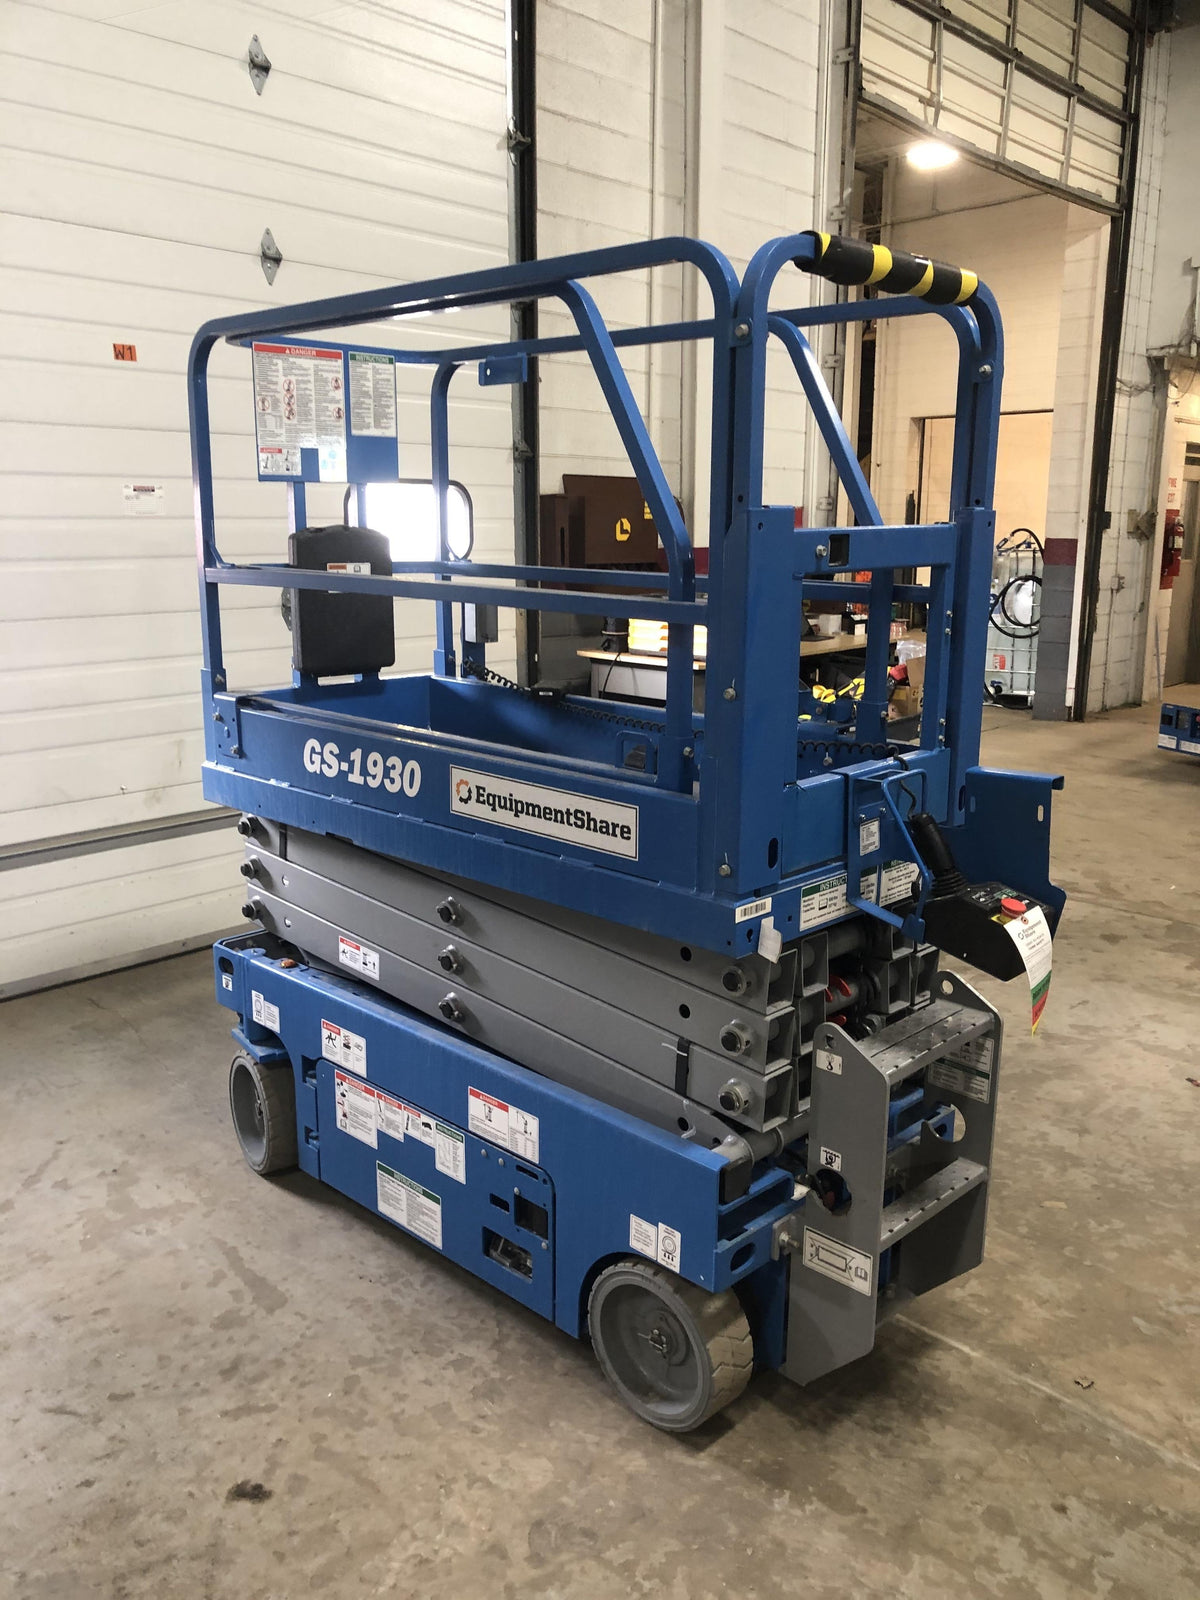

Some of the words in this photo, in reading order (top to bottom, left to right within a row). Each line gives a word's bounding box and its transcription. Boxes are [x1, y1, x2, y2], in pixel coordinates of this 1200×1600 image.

[113, 344, 133, 361] W1
[290, 348, 317, 356] DANGER
[303, 738, 422, 798] GS-1930
[475, 784, 632, 841] EquipmentShare
